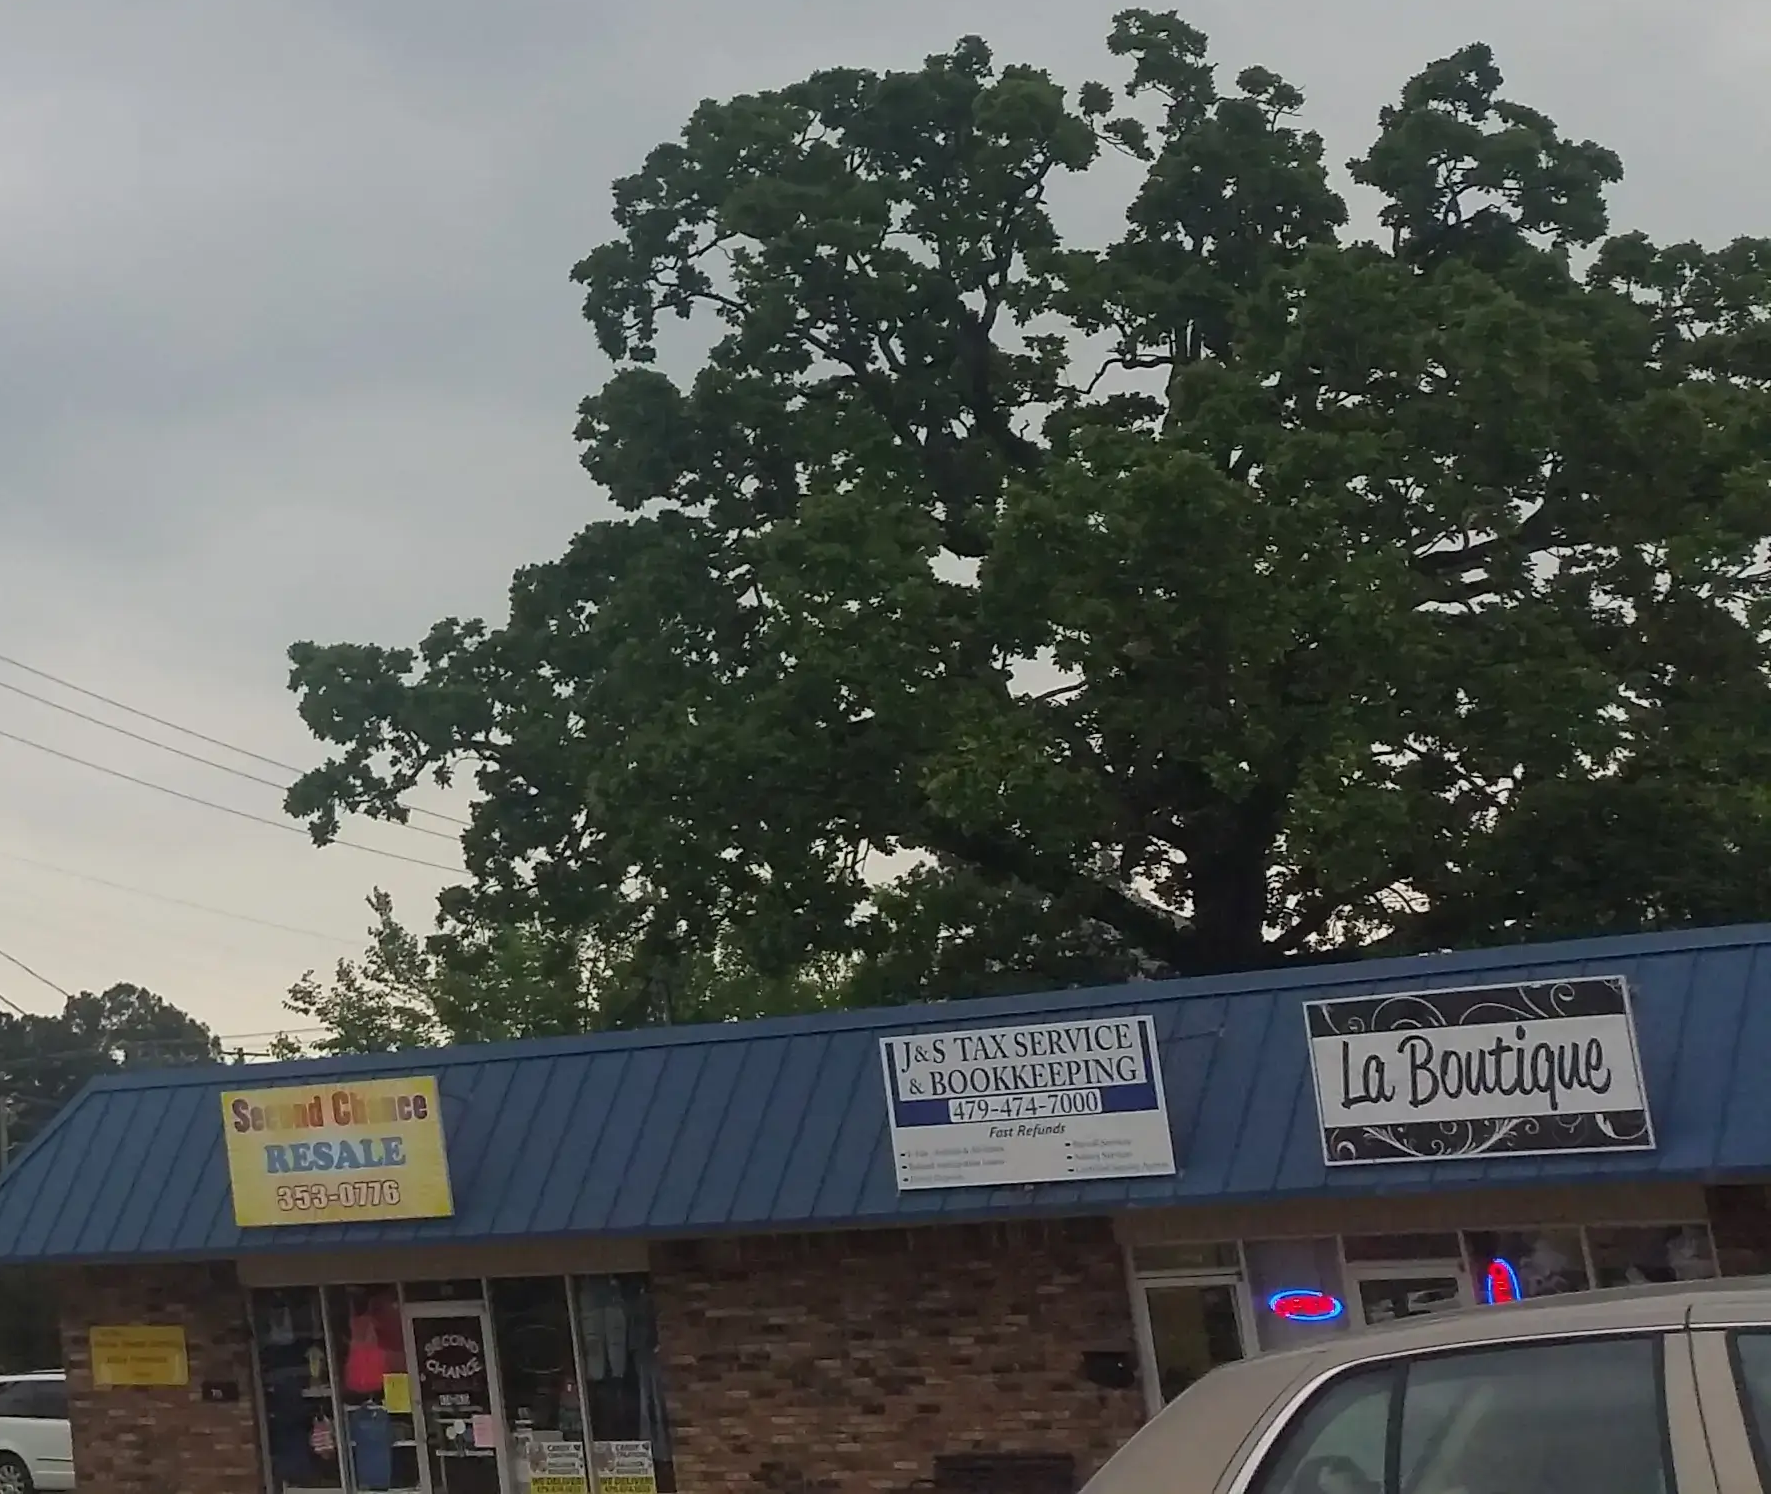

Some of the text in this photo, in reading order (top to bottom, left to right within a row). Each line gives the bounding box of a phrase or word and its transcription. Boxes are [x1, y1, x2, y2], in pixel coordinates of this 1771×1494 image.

[901, 1023, 1133, 1073] J&S TAX SERVICE
[909, 1055, 1138, 1096] & BOOKKEEPING
[1340, 1024, 1611, 1111] La Boutique
[231, 1090, 429, 1134] Second Chance
[953, 1091, 1099, 1121] 479-474-7000
[989, 1122, 1067, 1139] Fast Refunds
[263, 1136, 407, 1174] RESALE
[277, 1179, 402, 1212] 353-0776
[424, 1334, 479, 1357] SECOND
[425, 1357, 484, 1379] CHANCE
